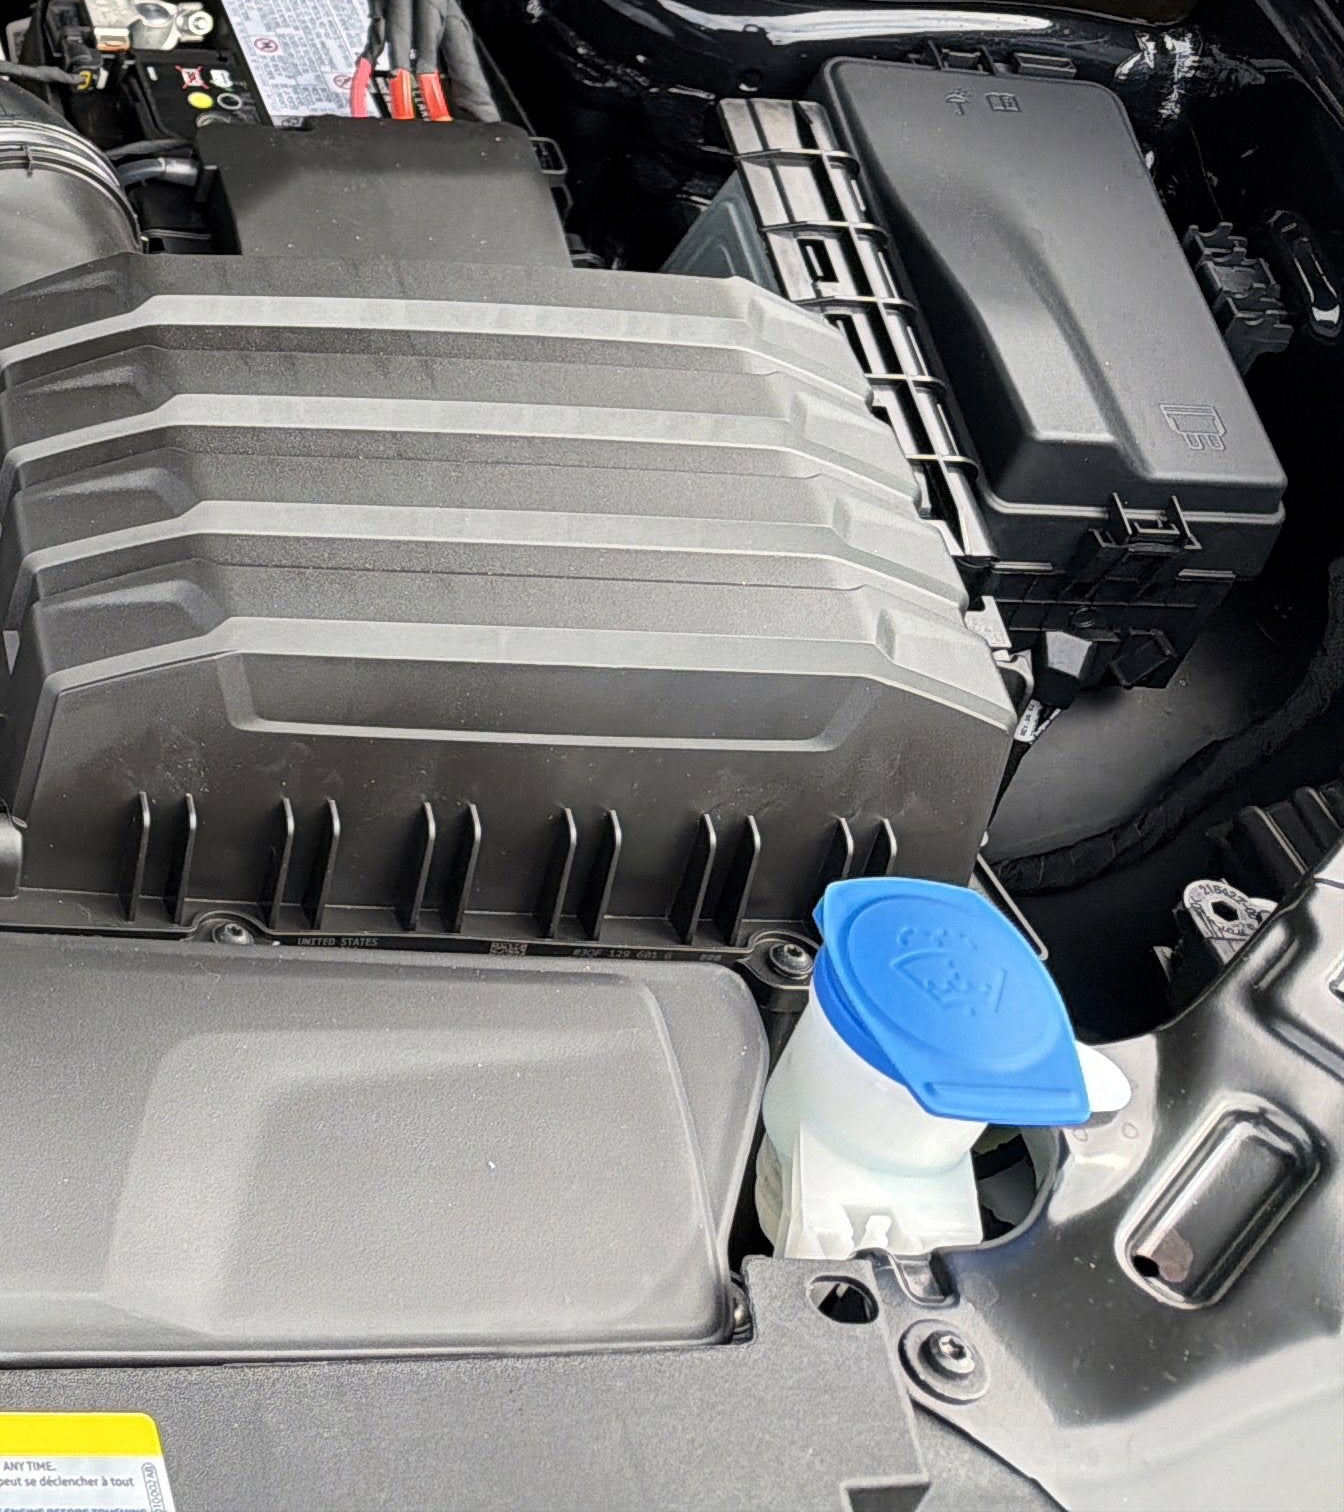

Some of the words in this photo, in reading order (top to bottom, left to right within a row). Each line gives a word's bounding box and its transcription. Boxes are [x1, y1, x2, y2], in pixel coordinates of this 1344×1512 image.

[297, 938, 336, 946] UNITED
[340, 938, 379, 947] STATES
[3, 1461, 23, 1473] ANY
[26, 1461, 56, 1472] TIME.
[25, 1479, 37, 1488] se
[39, 1475, 98, 1488] déclencher
[99, 1476, 107, 1488] à
[109, 1477, 135, 1489] tout
